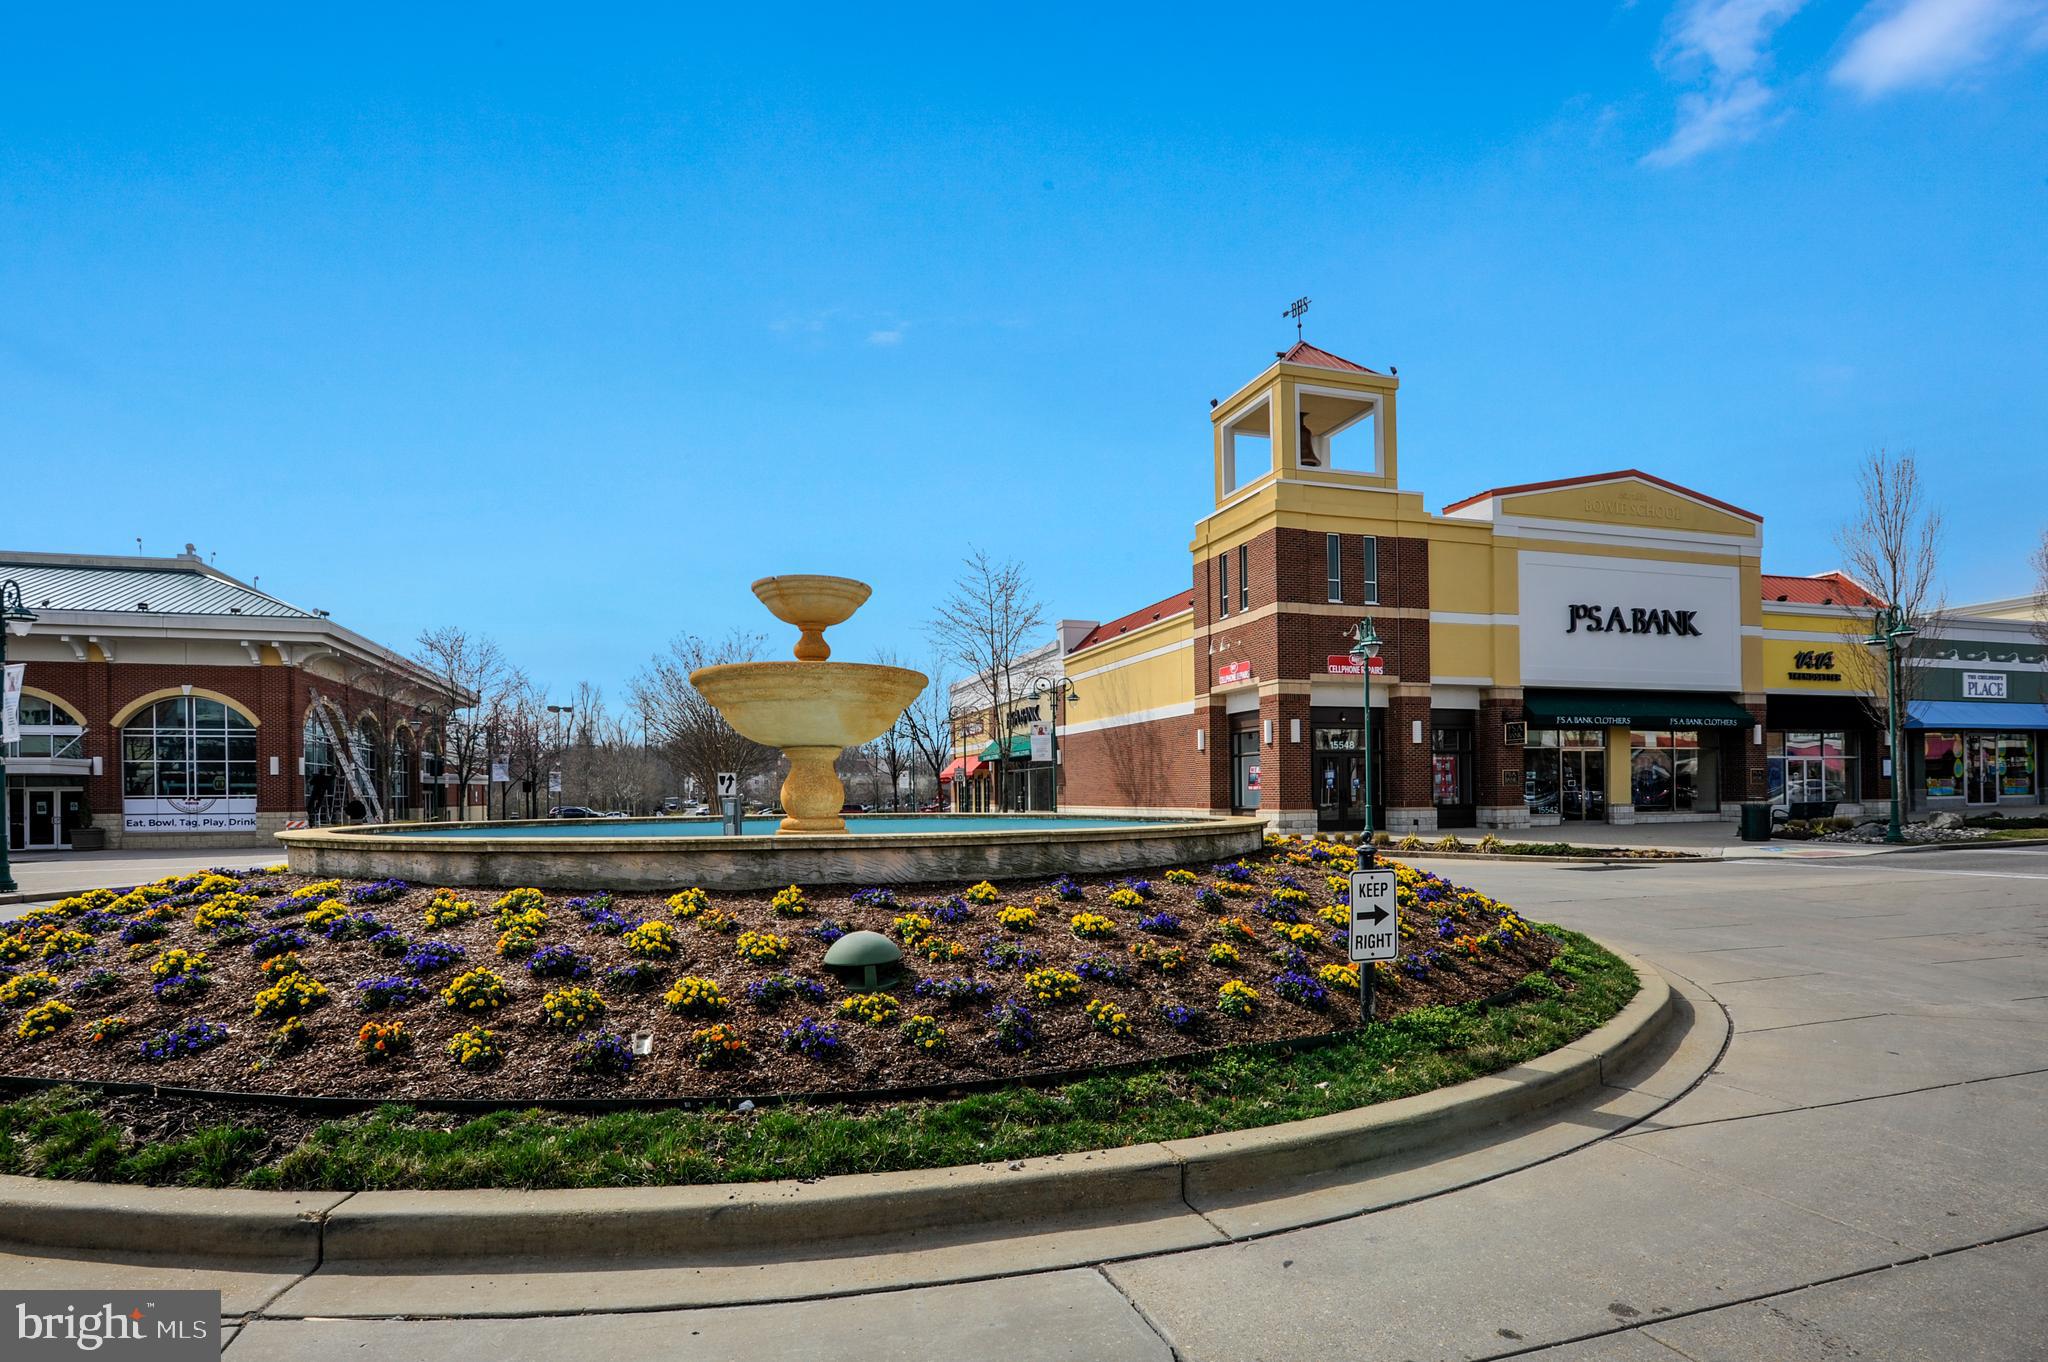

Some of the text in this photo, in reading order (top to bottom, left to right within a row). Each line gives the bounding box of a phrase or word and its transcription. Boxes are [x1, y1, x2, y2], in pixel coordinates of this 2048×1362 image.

[1328, 664, 1383, 675] CELLPHONE RPAIRS
[1967, 681, 2004, 697] PLACE
[1594, 716, 1631, 724] CLOTHIERS
[1703, 718, 1738, 726] CLOTHIERS
[1330, 741, 1355, 750] 15548
[1538, 806, 1559, 814] 15542
[1359, 882, 1388, 898] KEEP
[1355, 933, 1393, 950] RIGHT
